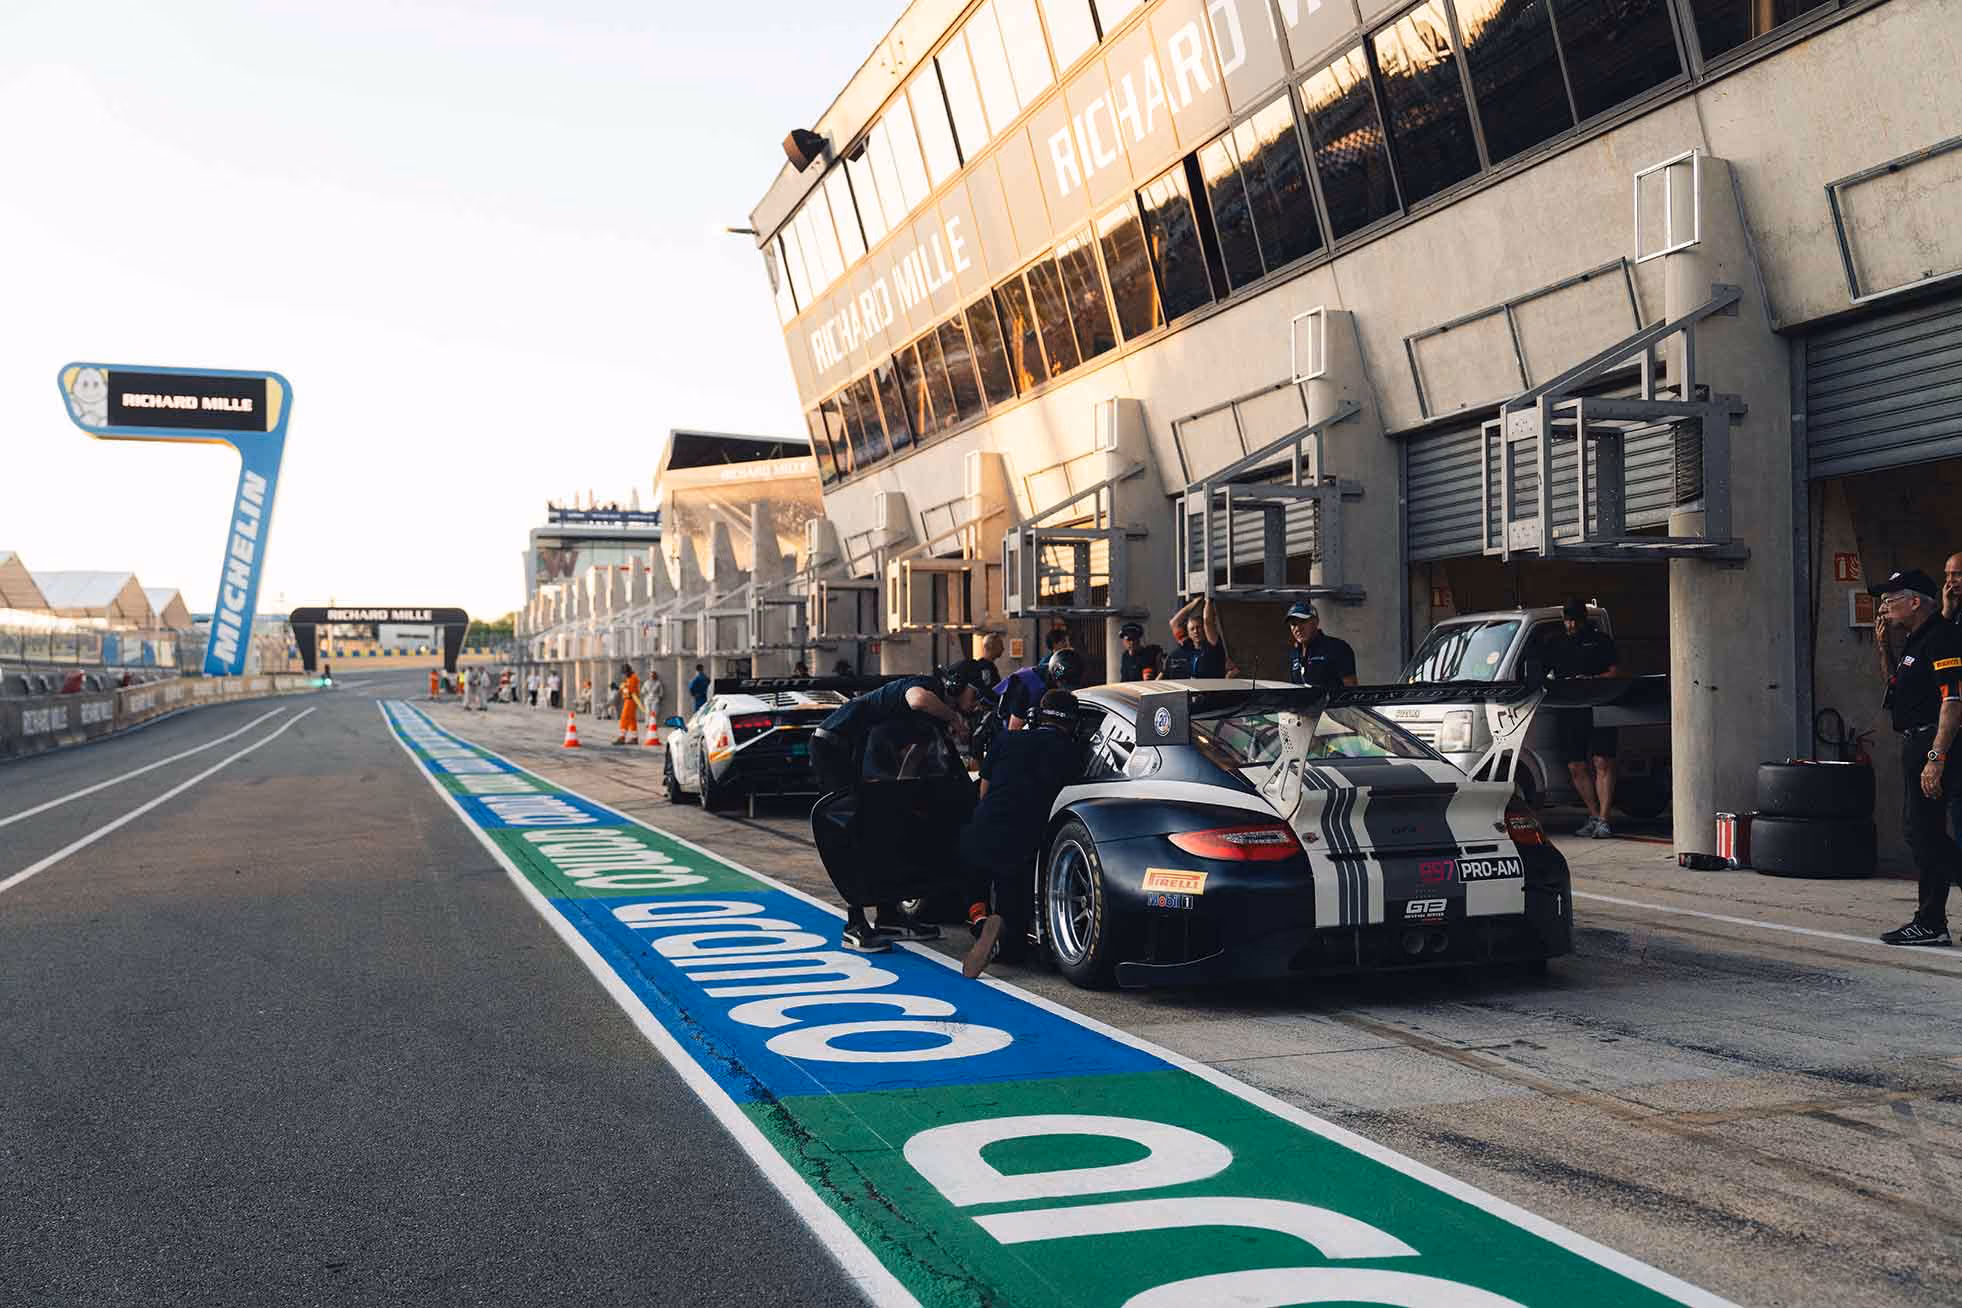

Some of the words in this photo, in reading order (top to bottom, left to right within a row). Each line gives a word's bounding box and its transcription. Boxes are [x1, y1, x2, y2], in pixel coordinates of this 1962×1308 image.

[1049, 0, 1246, 197] RICHARD
[811, 277, 893, 375] RICHARD
[892, 215, 972, 309] MILLE
[122, 393, 198, 409] RICHARD
[202, 396, 252, 412] MILLE
[214, 469, 266, 664] MICHELIN
[327, 609, 388, 621] RICHARD
[391, 609, 433, 621] MILLE
[1461, 860, 1520, 878] PRO-AM
[1148, 872, 1201, 889] PIRELLI
[1406, 898, 1447, 914] GT3
[612, 901, 1015, 1062] aramco
